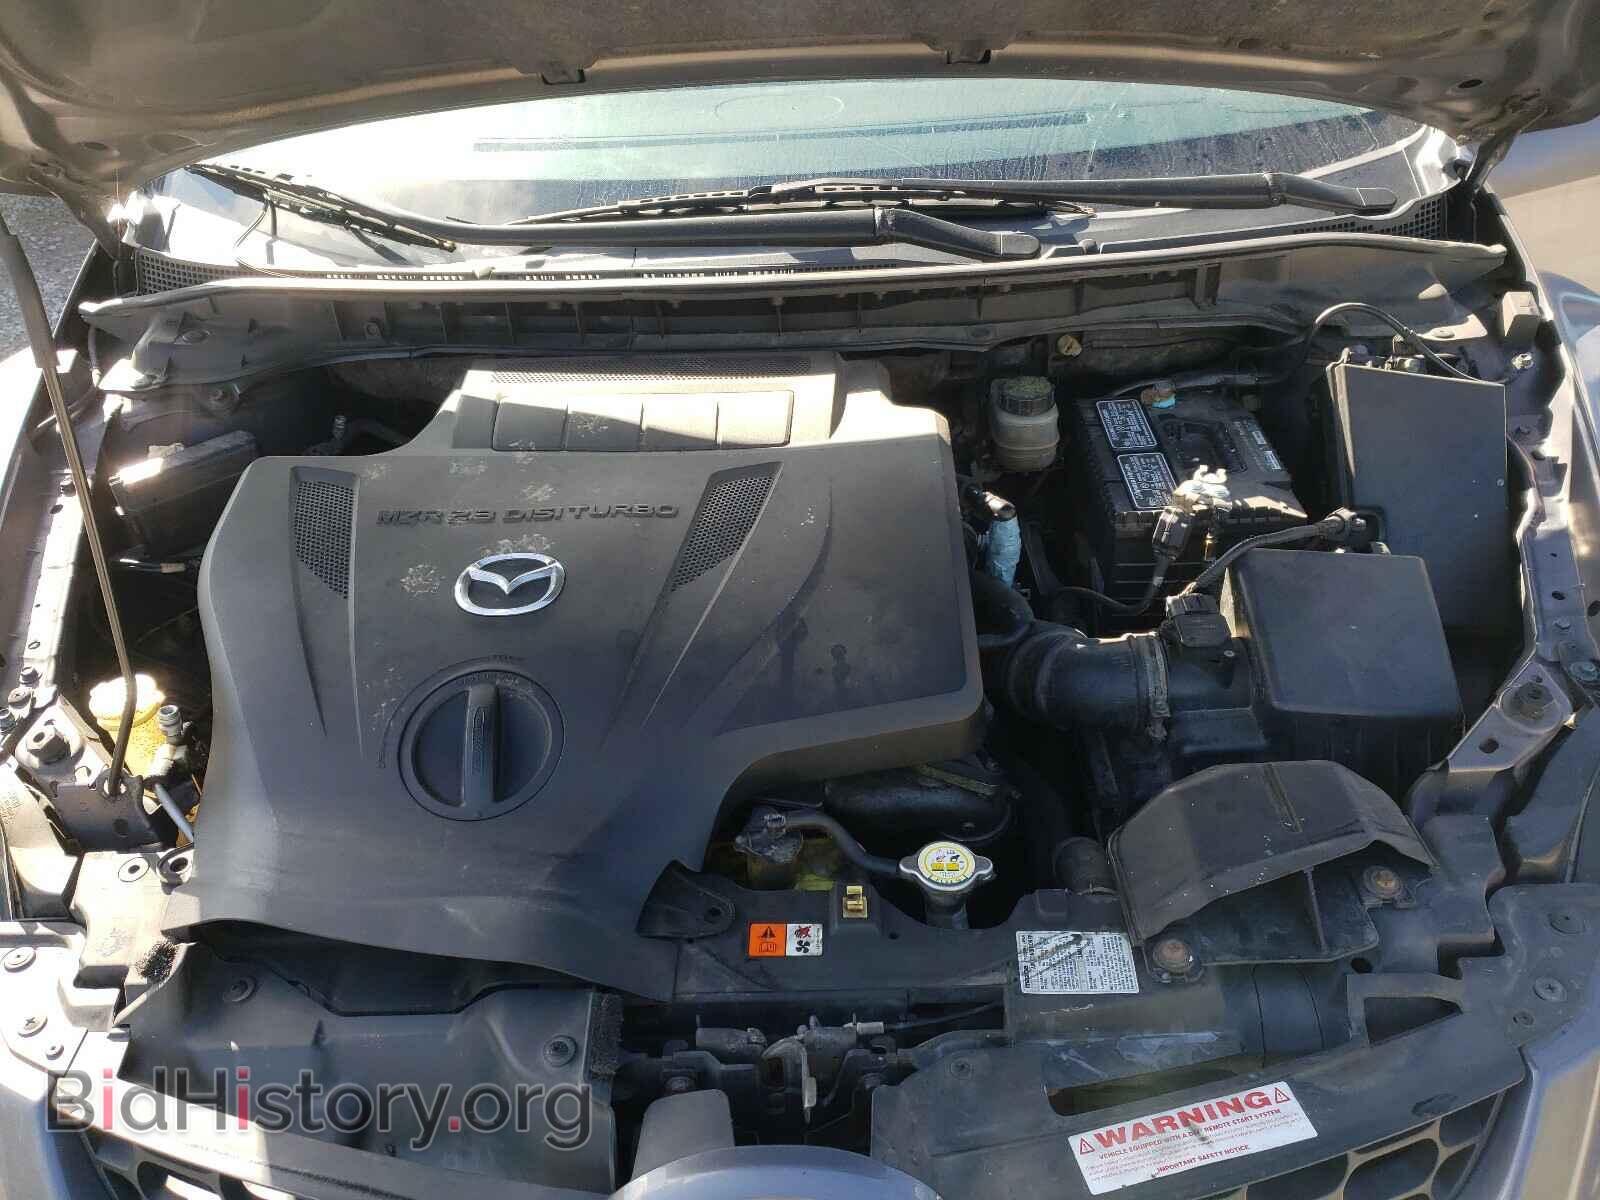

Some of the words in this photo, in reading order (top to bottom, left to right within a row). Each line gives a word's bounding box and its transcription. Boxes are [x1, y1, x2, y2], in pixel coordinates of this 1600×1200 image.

[567, 503, 680, 520] TURBO
[1093, 1090, 1273, 1149] WARNING
[1098, 1148, 1129, 1160] VEHICLE
[1129, 1139, 1162, 1153] EQUIPPED
[1165, 1134, 1181, 1143] WITH
[1204, 1122, 1231, 1134] REMOTE
[1232, 1115, 1253, 1125] START
[1254, 1108, 1281, 1119] SYSTEM
[1156, 1157, 1197, 1174] IMPORTANT
[1198, 1150, 1224, 1162] SAFETY
[1224, 1144, 1249, 1155] NOTICE
